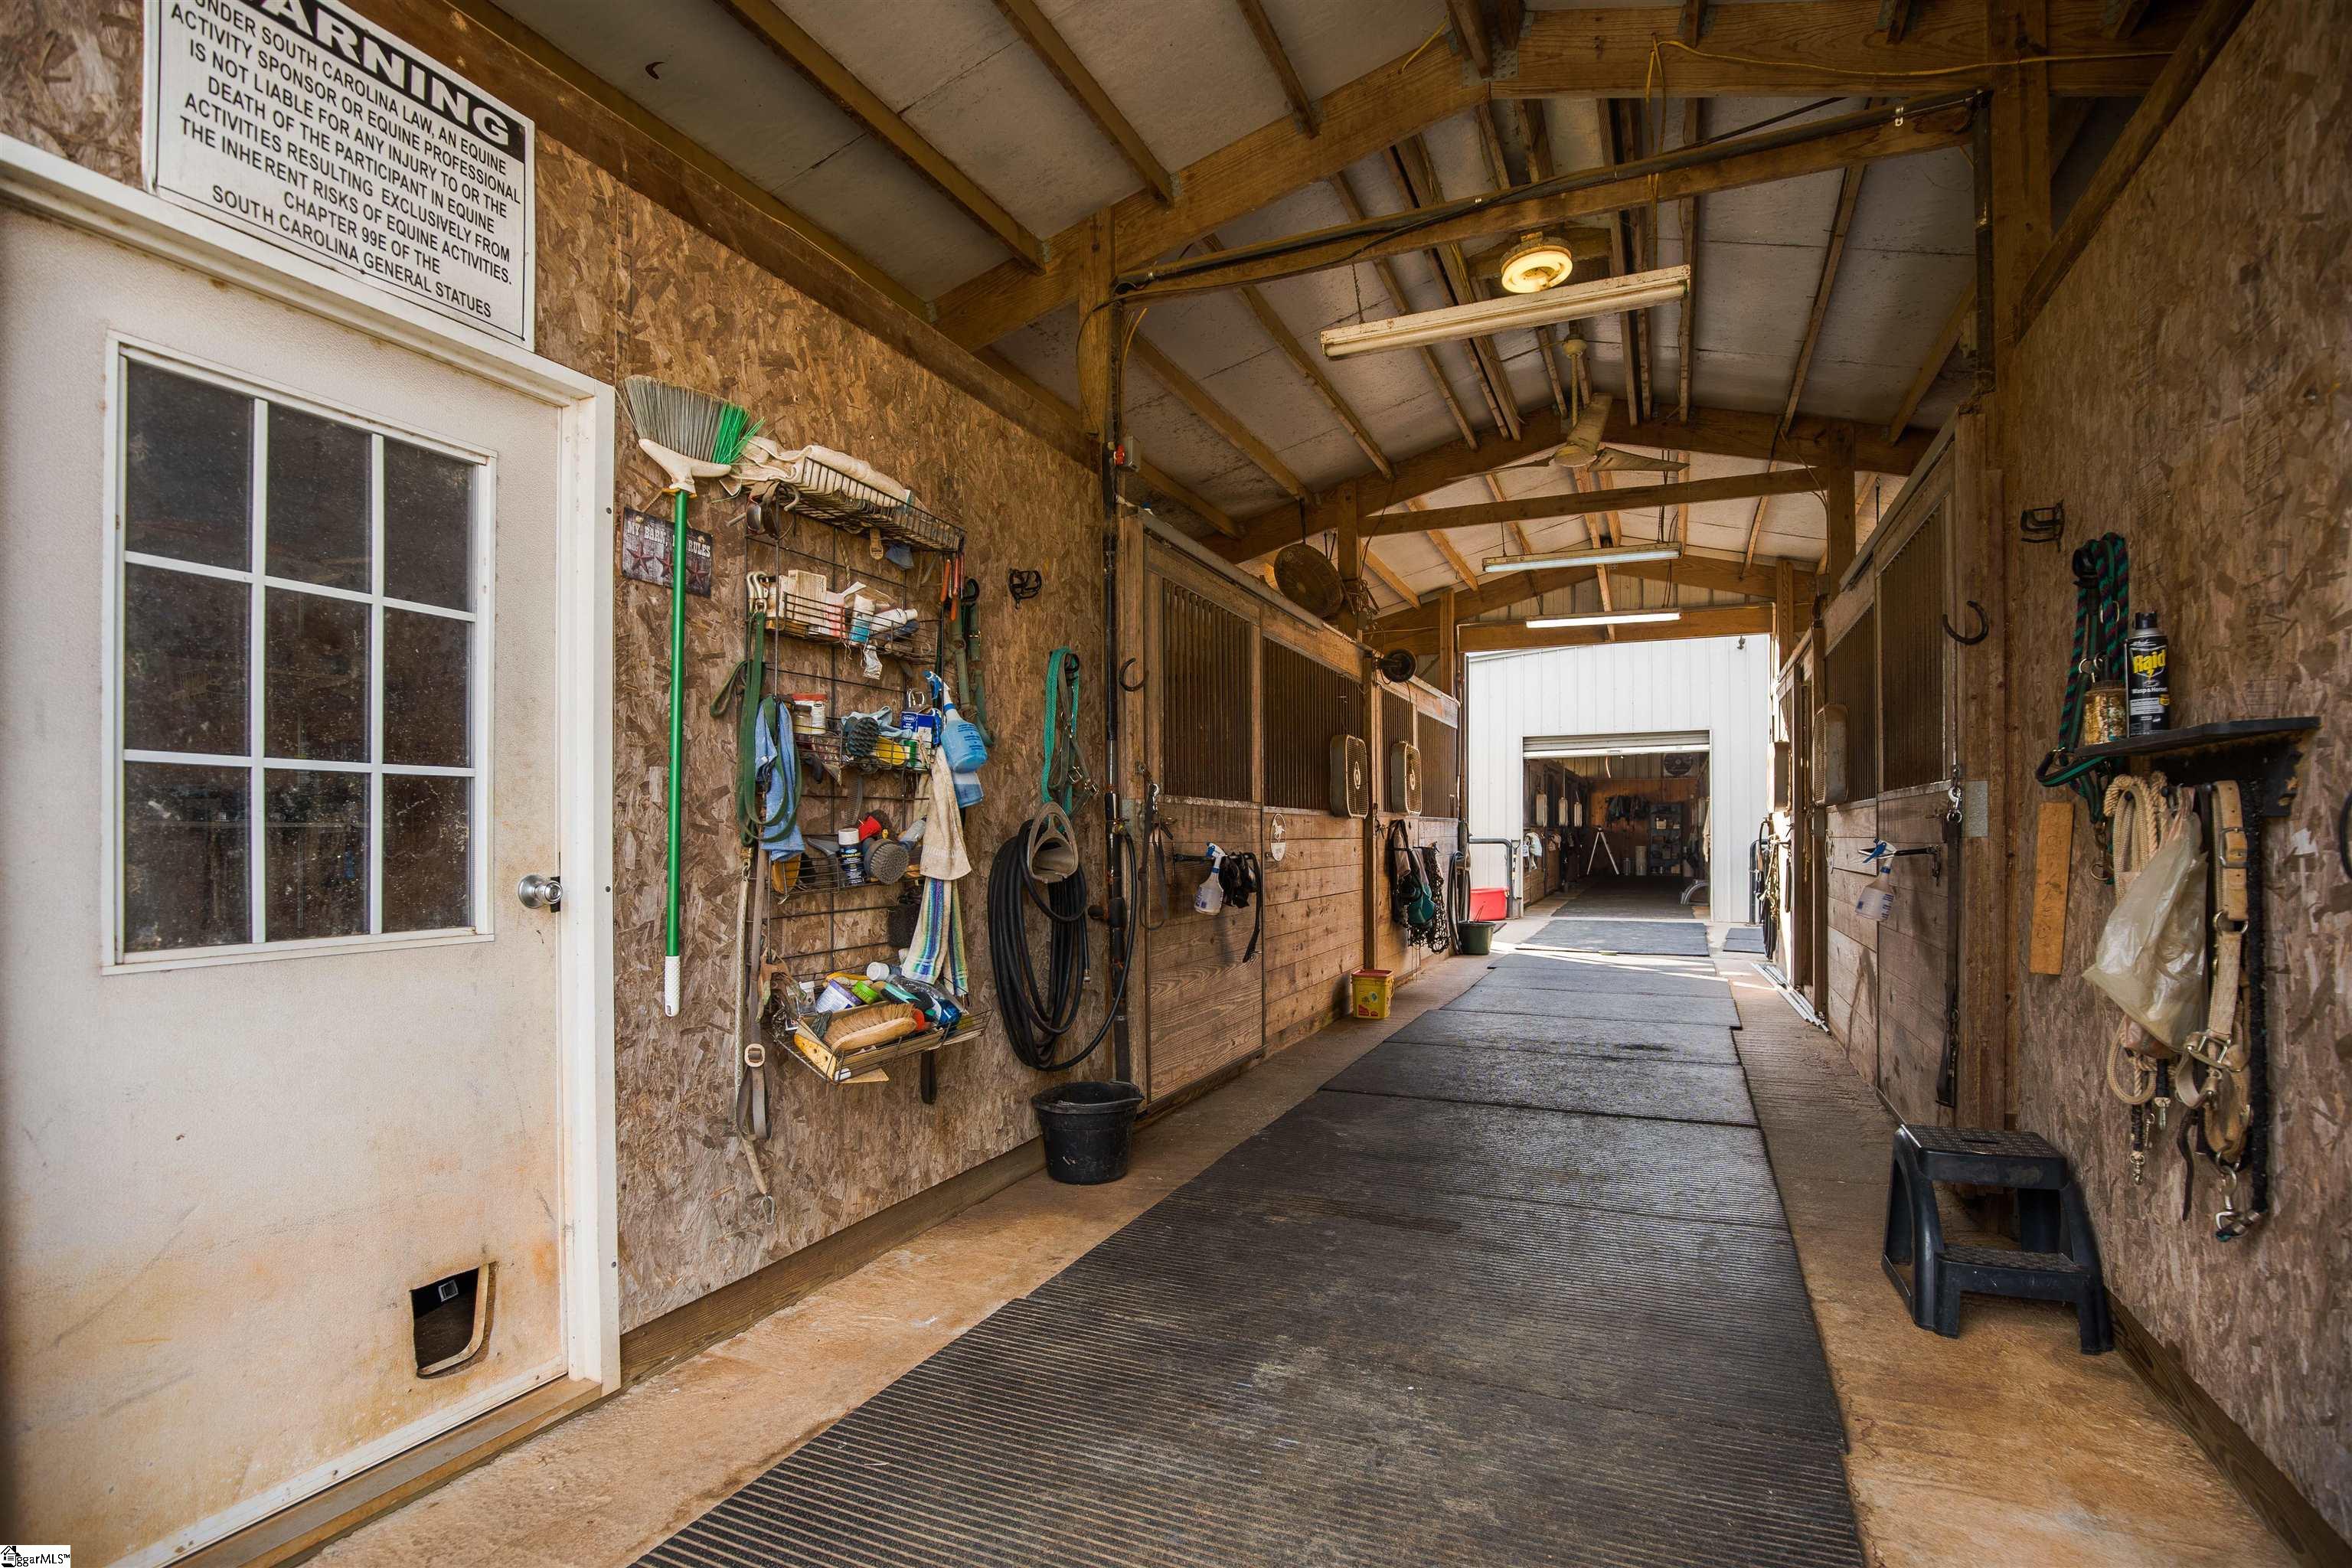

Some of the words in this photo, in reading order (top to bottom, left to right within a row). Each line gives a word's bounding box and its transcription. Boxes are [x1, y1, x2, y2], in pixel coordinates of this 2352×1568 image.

[172, 3, 253, 59] ACTIVITY
[258, 51, 337, 107] SPONSOR
[341, 96, 364, 121] OR
[368, 109, 420, 152] EQUINE
[424, 139, 521, 205] PROFESSIONAL
[190, 39, 207, 62] IS
[212, 51, 249, 83] NOT
[254, 73, 313, 119] LIABLE
[318, 107, 350, 139] FOR
[354, 128, 384, 155] ANY
[389, 144, 437, 181] INJURY
[440, 171, 459, 193] TO
[462, 183, 480, 205] OR
[483, 193, 507, 218] THE
[249, 0, 509, 145] ARNING
[262, 26, 316, 70] SOUTH
[322, 61, 399, 116] CAROLINA
[403, 105, 435, 139] LAW,
[439, 127, 457, 148] AN
[461, 138, 507, 175] EQUINE
[179, 115, 217, 149] THE
[221, 135, 309, 191] INHERENT
[313, 178, 359, 214] RISKS
[363, 203, 383, 224] OF
[387, 214, 439, 251] EQUINE
[441, 240, 513, 286] ACTIVITIES.
[185, 93, 283, 153] ACTIVITIES
[287, 141, 374, 197] RESULTING
[382, 187, 472, 243] EXCLUSIVELY
[475, 233, 511, 263] FROM
[208, 75, 266, 120] DEATH
[273, 109, 296, 132] OF
[299, 122, 331, 152] THE
[335, 140, 428, 199] PARTICIPANT
[431, 188, 444, 209] IN
[448, 198, 495, 234] EQUINE
[212, 184, 275, 225] SOUTH
[279, 214, 360, 264] CAROLINA
[363, 252, 432, 294] GENERAL
[435, 281, 492, 318] STATUES
[284, 191, 358, 240] CHAPTER
[361, 226, 387, 252] 99E
[390, 240, 410, 260] OF
[414, 249, 441, 275] THE
[688, 540, 710, 557] RULES
[2132, 649, 2166, 675] Raid
